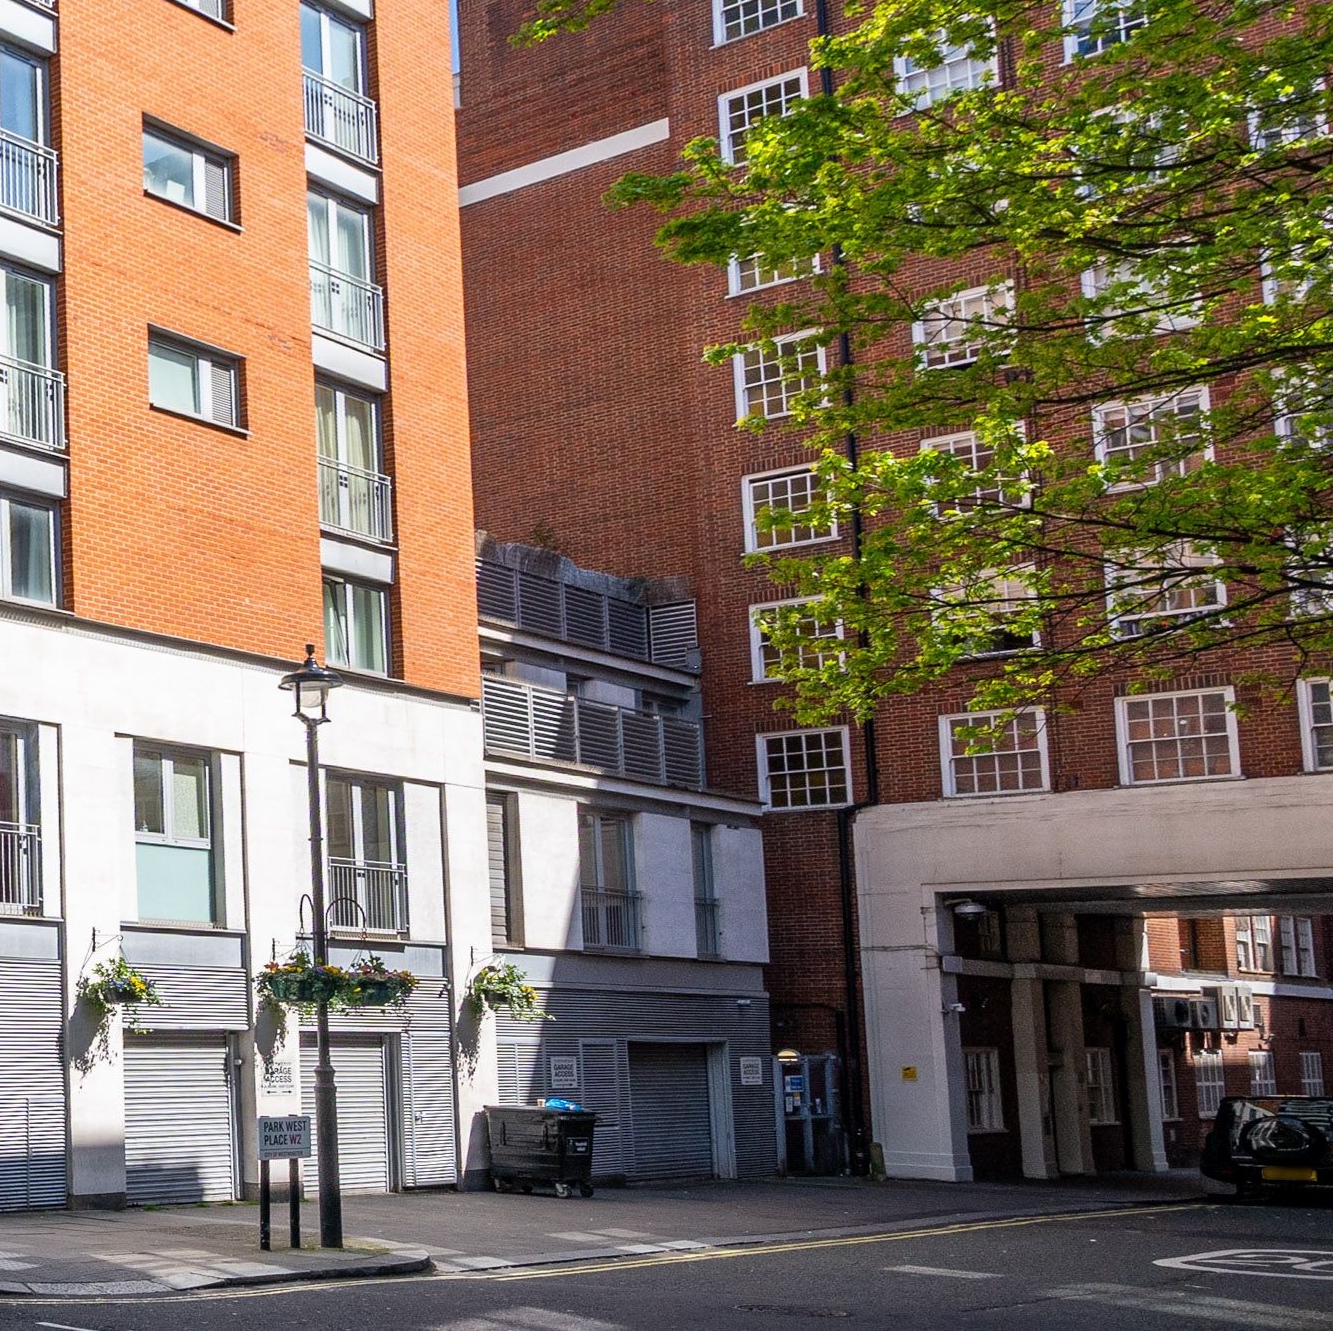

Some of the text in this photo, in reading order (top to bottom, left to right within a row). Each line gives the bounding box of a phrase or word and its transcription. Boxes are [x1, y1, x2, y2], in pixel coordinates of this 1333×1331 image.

[265, 1067, 292, 1075] RAGE
[264, 1120, 307, 1133] PARK WEST
[264, 1134, 302, 1146] PLACE W2
